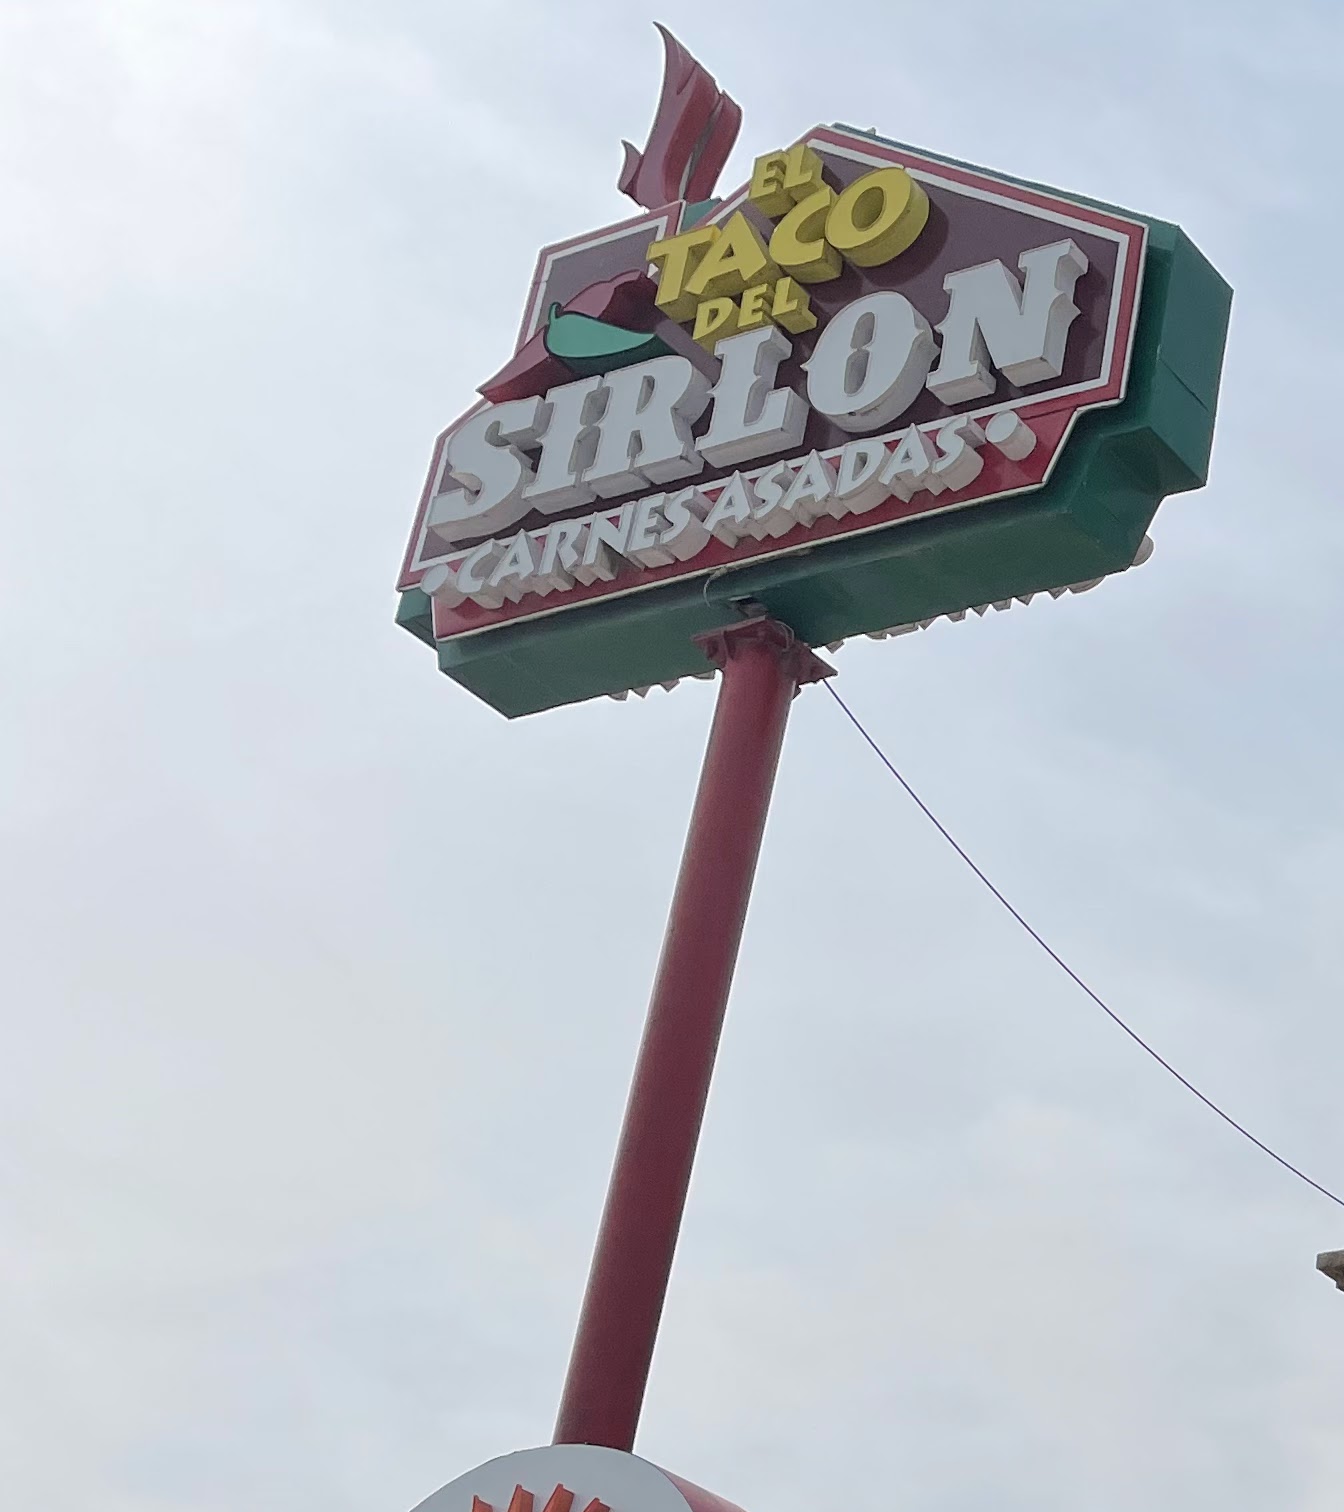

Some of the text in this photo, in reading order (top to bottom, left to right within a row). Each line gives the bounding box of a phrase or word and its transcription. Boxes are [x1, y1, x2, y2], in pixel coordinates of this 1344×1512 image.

[648, 167, 926, 316] TACO
[750, 143, 822, 212] EL
[693, 277, 813, 343] DEL
[428, 238, 1086, 540] SIRLON
[456, 414, 980, 606] CARNES ASADAS
